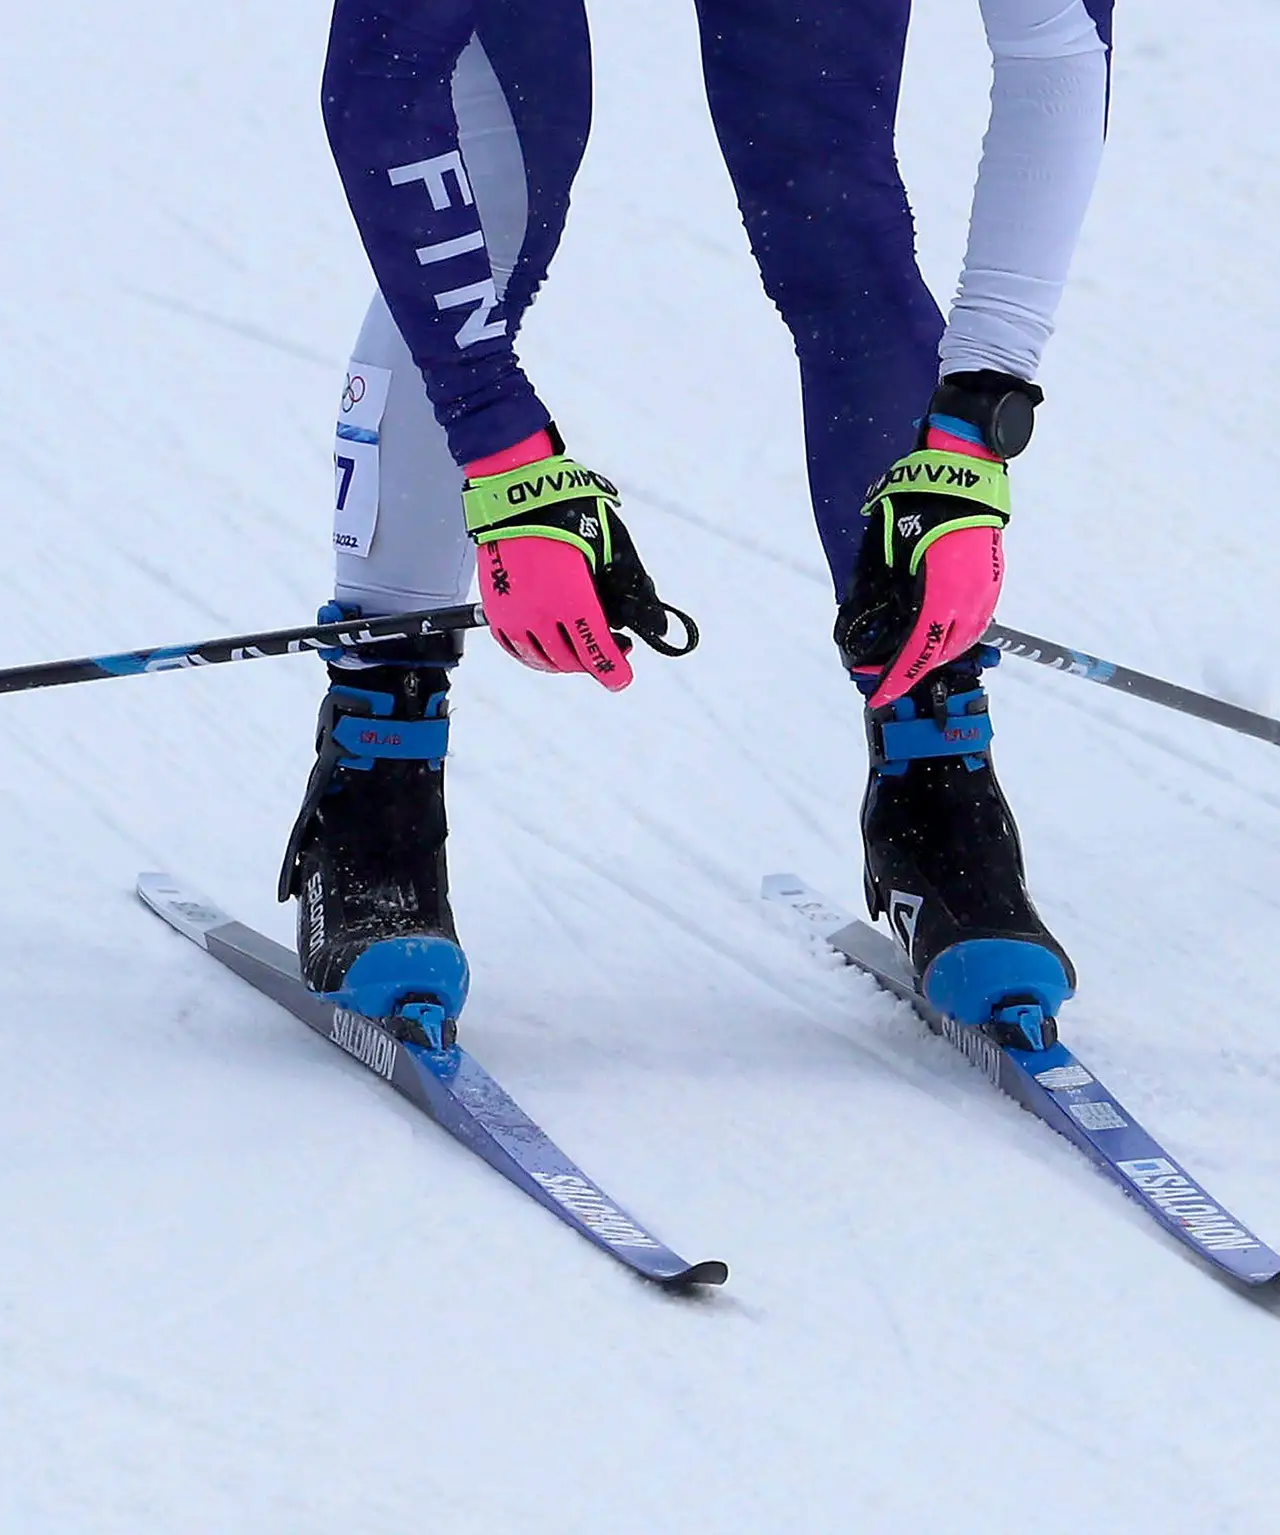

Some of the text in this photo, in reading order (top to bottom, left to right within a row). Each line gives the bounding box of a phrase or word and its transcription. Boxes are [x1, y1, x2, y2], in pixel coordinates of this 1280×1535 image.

[387, 150, 507, 350] FIN
[333, 452, 355, 511] 7
[329, 1007, 397, 1081] SALOMON
[1133, 1174, 1261, 1251] SALOMON
